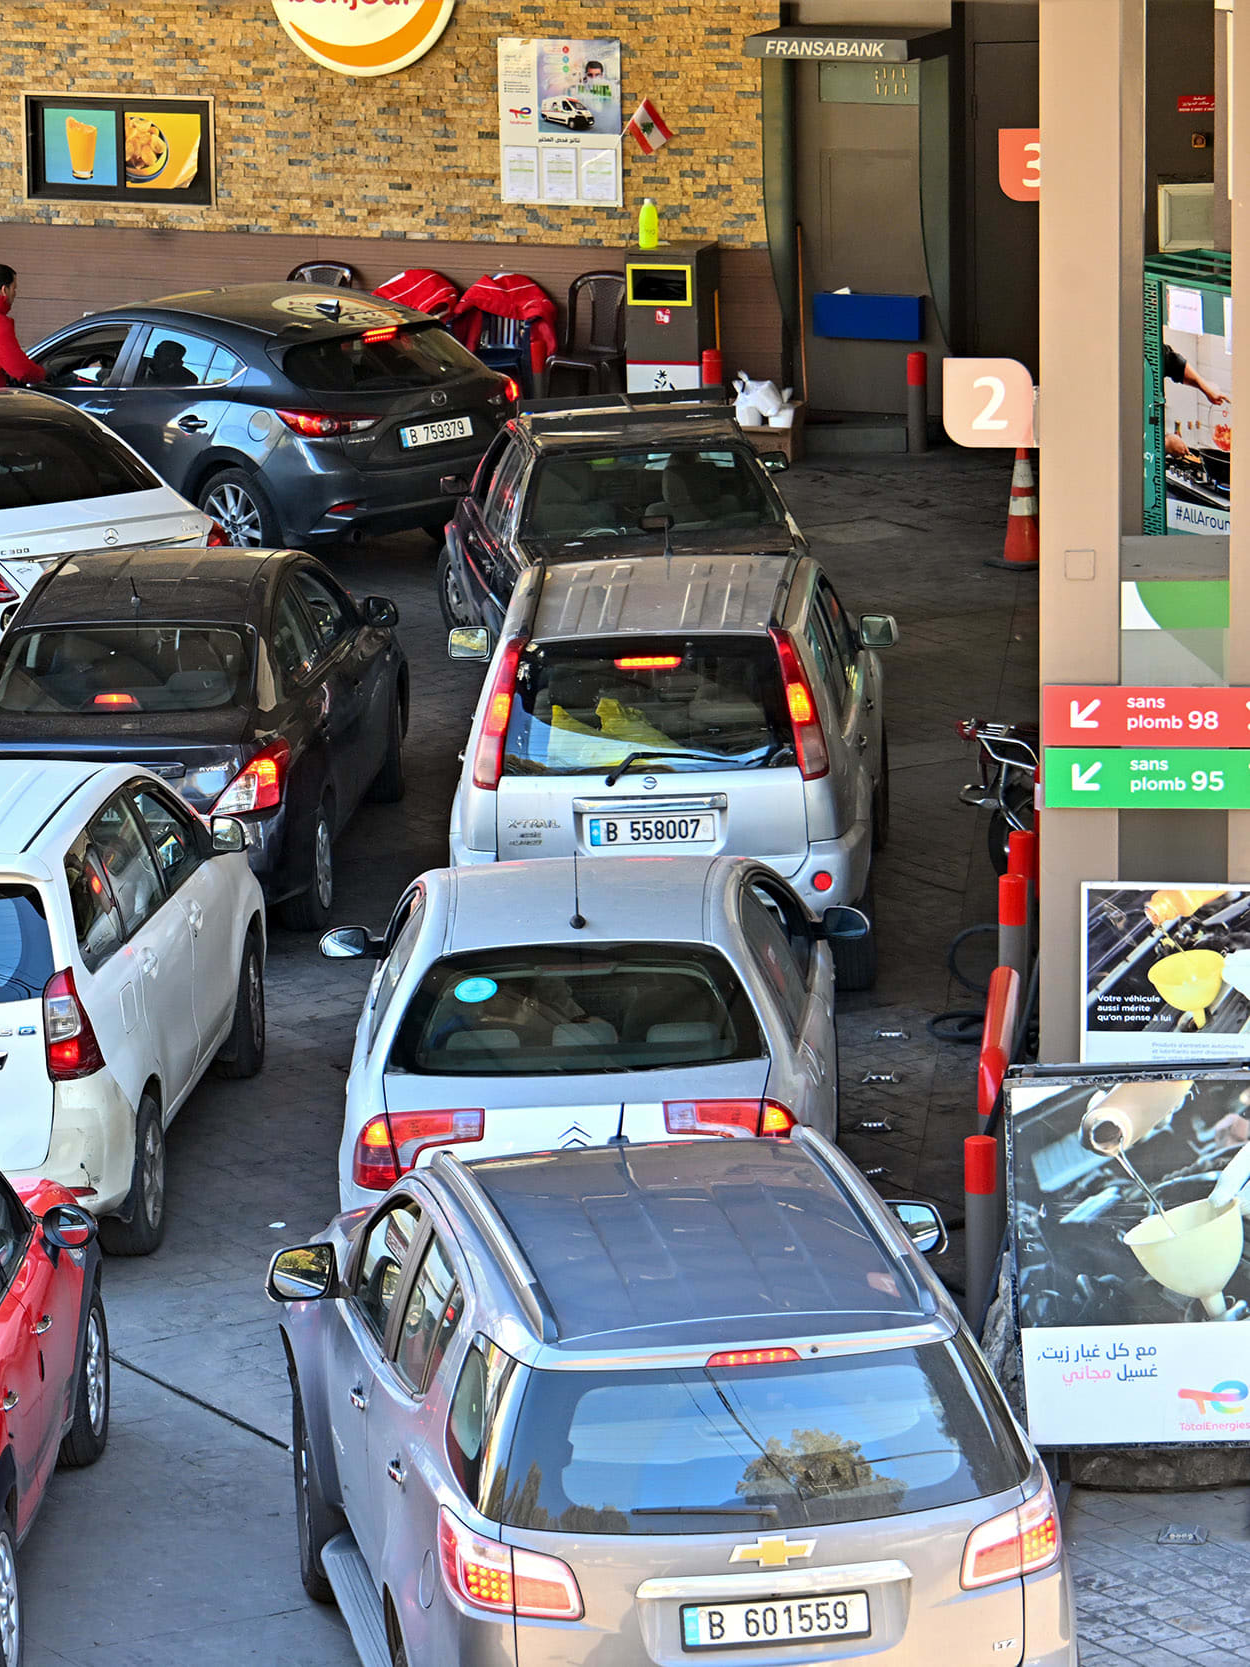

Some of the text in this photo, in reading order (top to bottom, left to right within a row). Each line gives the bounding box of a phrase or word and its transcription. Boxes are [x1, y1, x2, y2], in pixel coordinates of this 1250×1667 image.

[765, 40, 885, 57] FRANSABANK
[971, 376, 1008, 430] 2
[409, 420, 465, 444] B 759379
[1126, 697, 1165, 709] sans
[1127, 710, 1219, 731] plomb 98
[1130, 759, 1169, 771] sans
[1130, 770, 1225, 793] plomb 95
[606, 818, 701, 842] B 558007
[1097, 995, 1161, 1003] Votre véhicule
[1097, 1004, 1151, 1012] aussi mérite
[1152, 1014, 1159, 1022] à
[1160, 1014, 1172, 1022] lui
[1074, 1343, 1100, 1362] غيار
[1106, 1343, 1130, 1360] كل
[1135, 1345, 1157, 1361] مع
[1062, 1363, 1158, 1386] غسيل مجاني
[1180, 1421, 1250, 1433] TotalEnergies
[708, 1600, 849, 1640] B 601559
